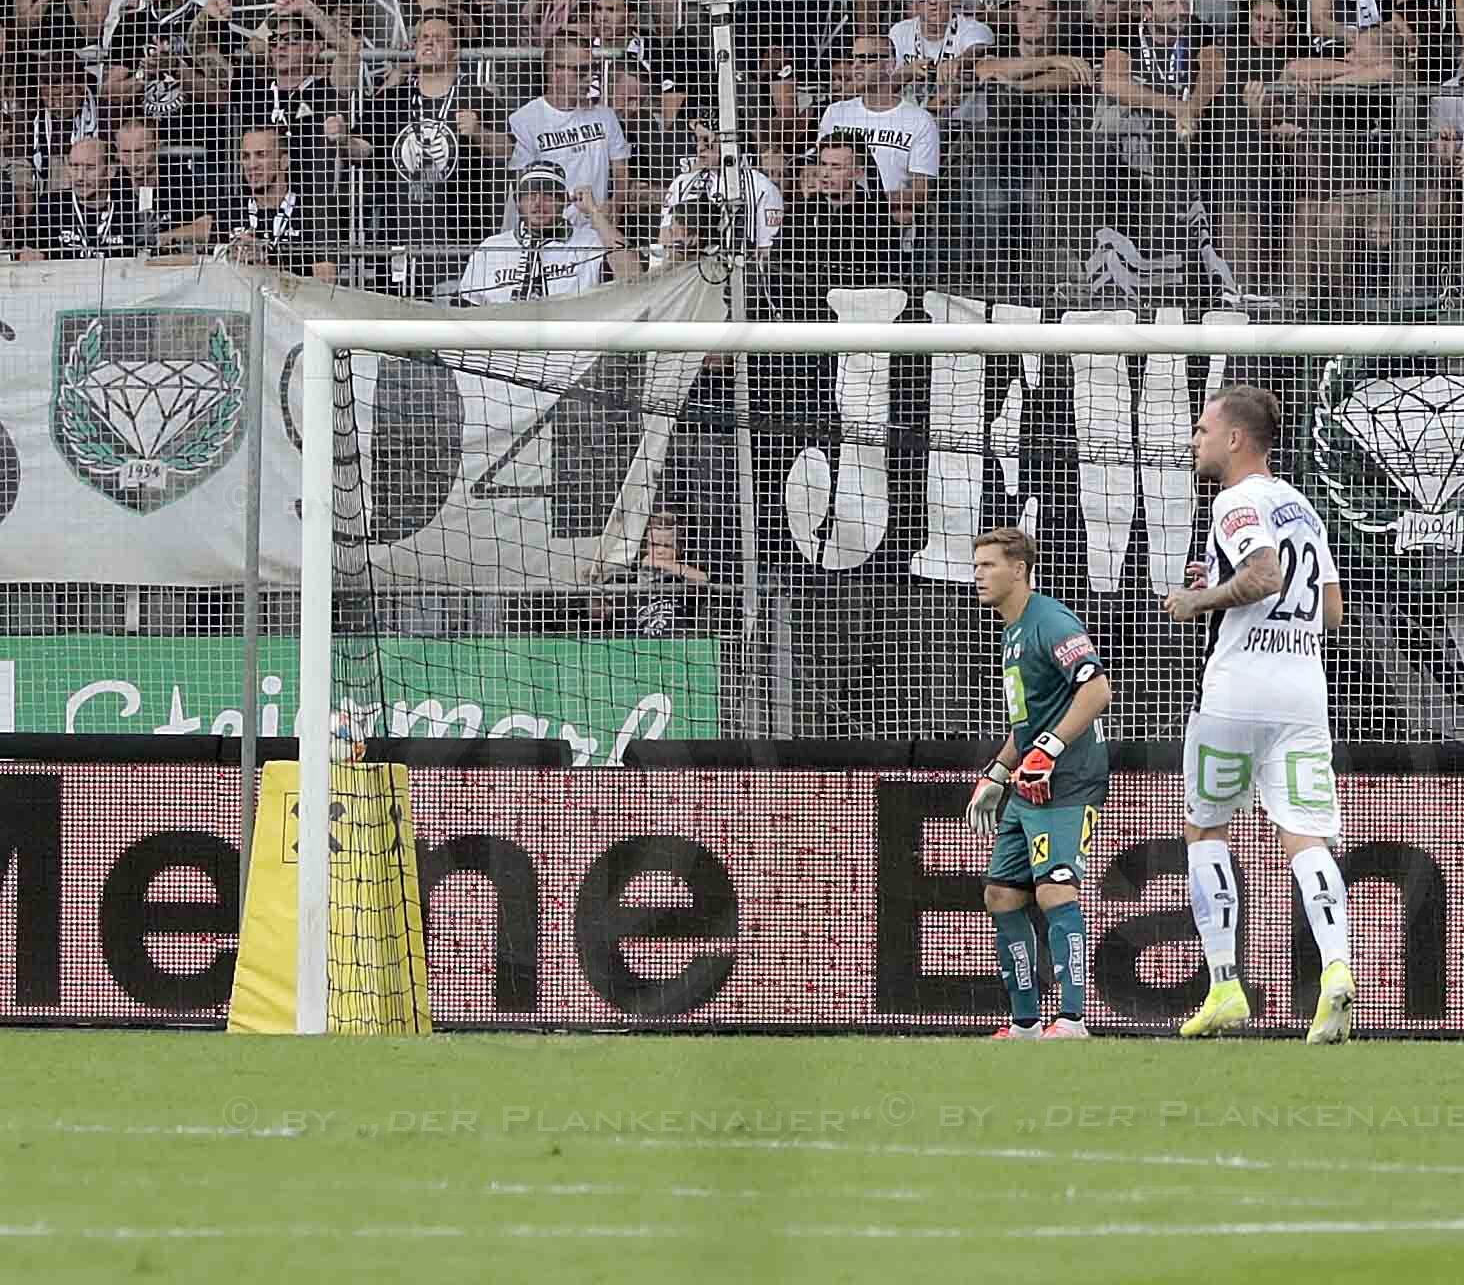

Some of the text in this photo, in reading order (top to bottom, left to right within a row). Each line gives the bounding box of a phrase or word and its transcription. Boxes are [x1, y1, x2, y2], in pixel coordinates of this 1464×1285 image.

[537, 129, 577, 151] STURM
[876, 130, 913, 149] GRAZ
[1405, 517, 1456, 545] 1994
[1267, 536, 1322, 623] 23
[0, 773, 740, 1017] ene
